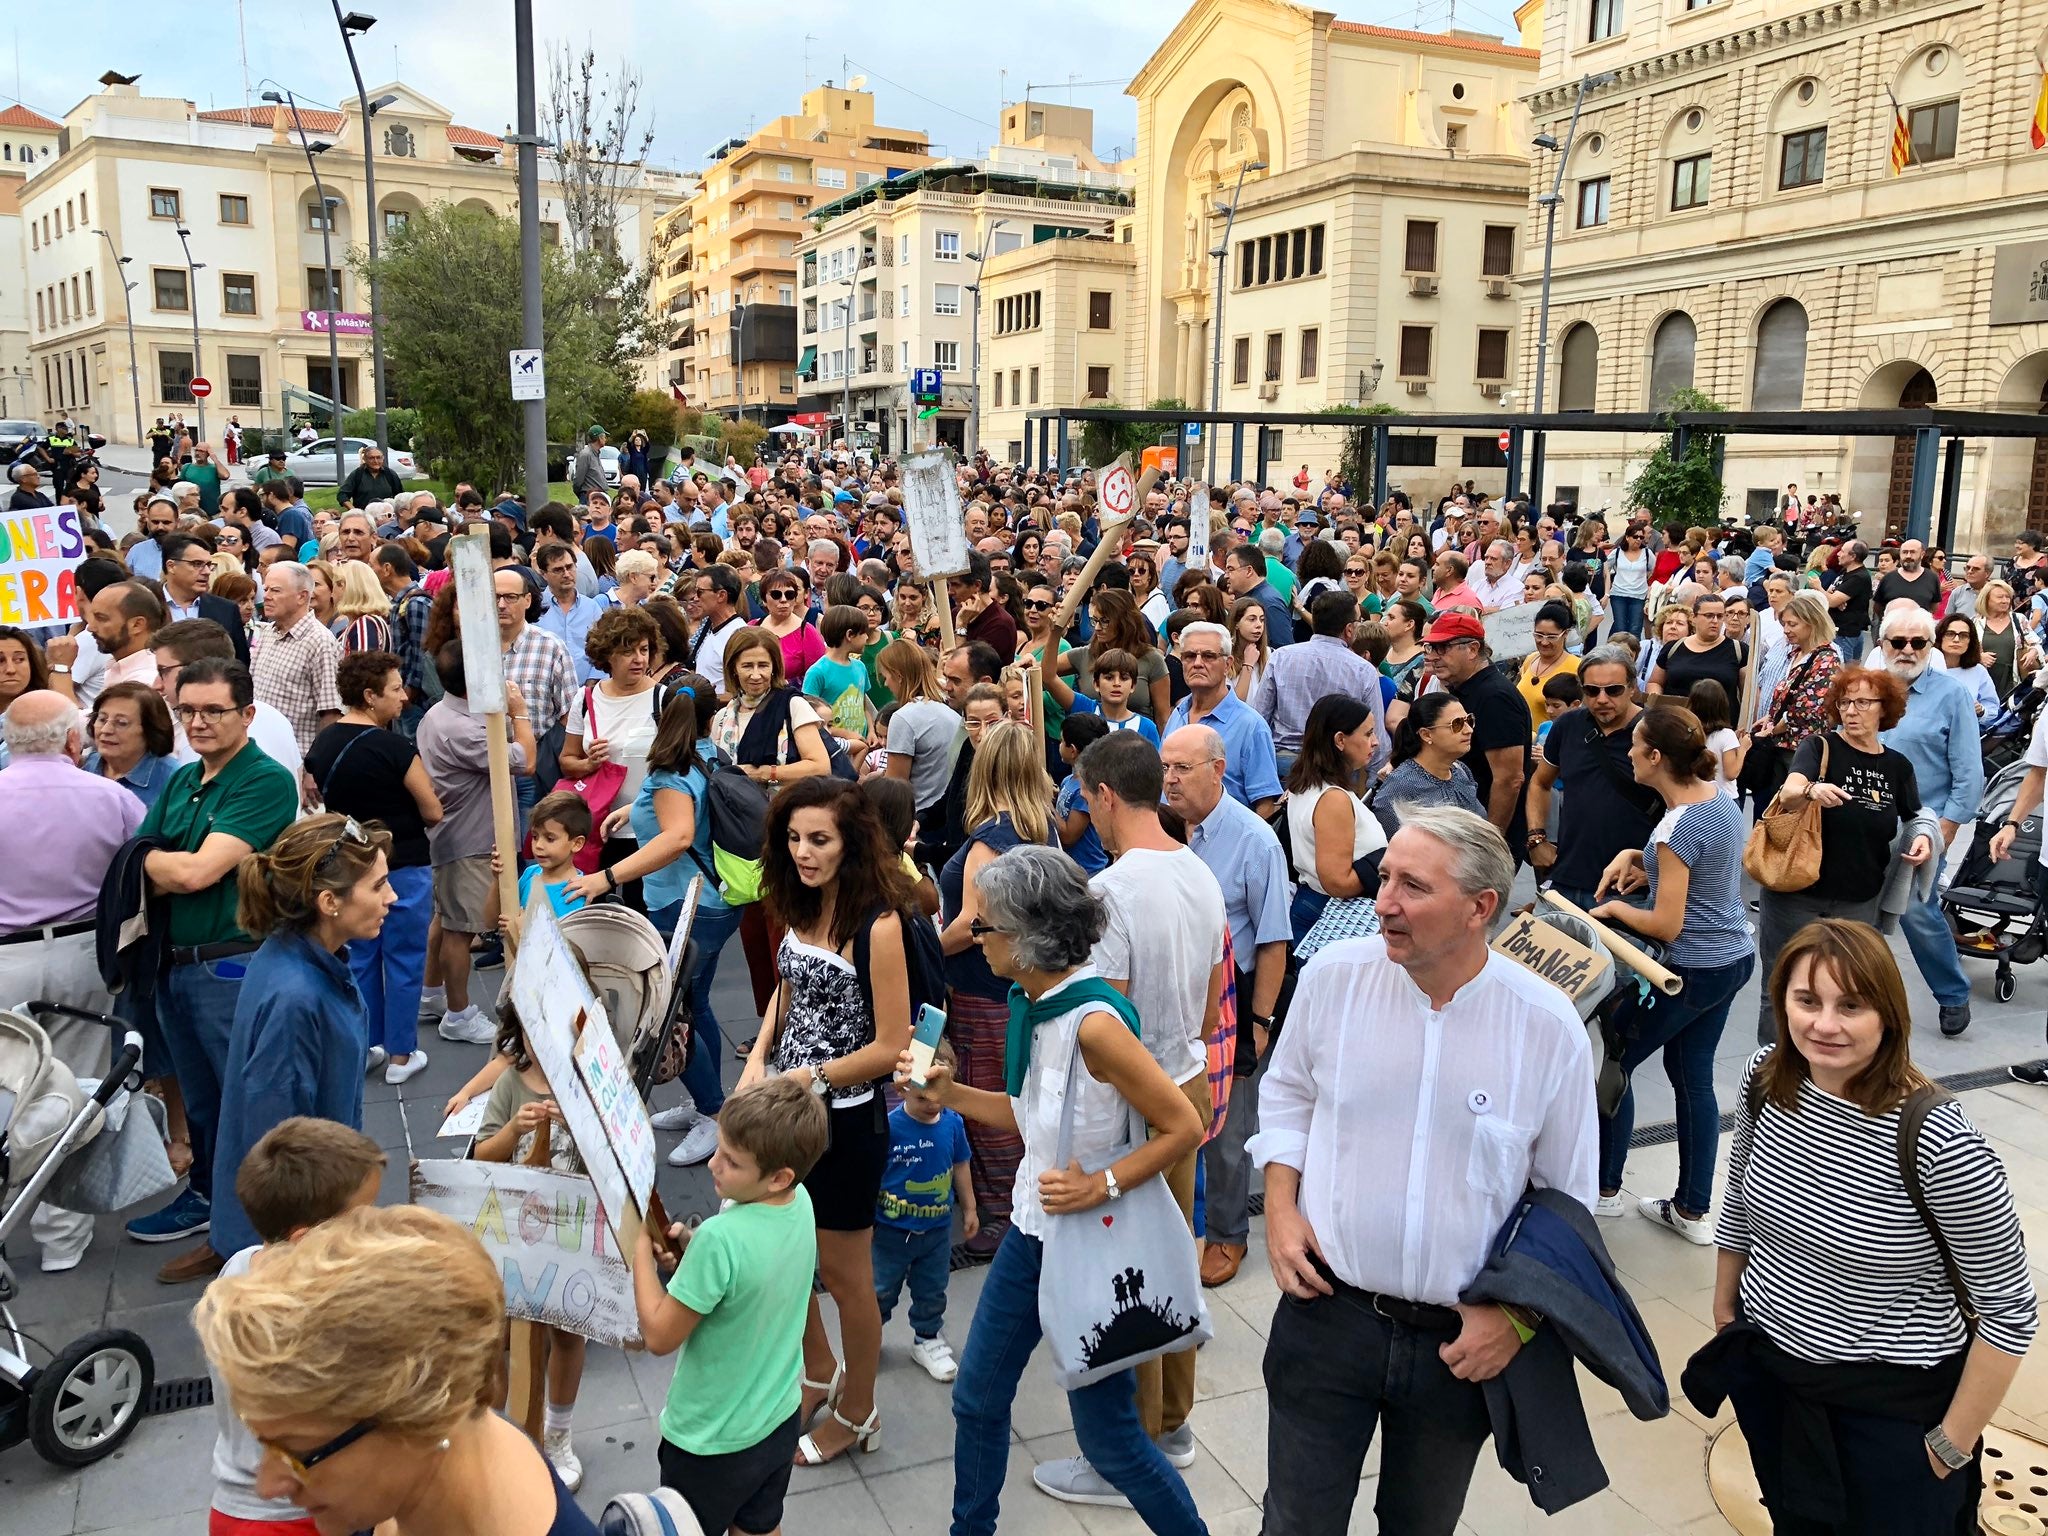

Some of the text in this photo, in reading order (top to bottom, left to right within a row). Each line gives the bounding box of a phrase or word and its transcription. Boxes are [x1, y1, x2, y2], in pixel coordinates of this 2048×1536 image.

[922, 371, 937, 392] P
[1187, 423, 1198, 434] P
[1852, 766, 1862, 776] la
[1841, 784, 1855, 792] de
[1862, 788, 1894, 800] chcun
[503, 1256, 597, 1324] NO
